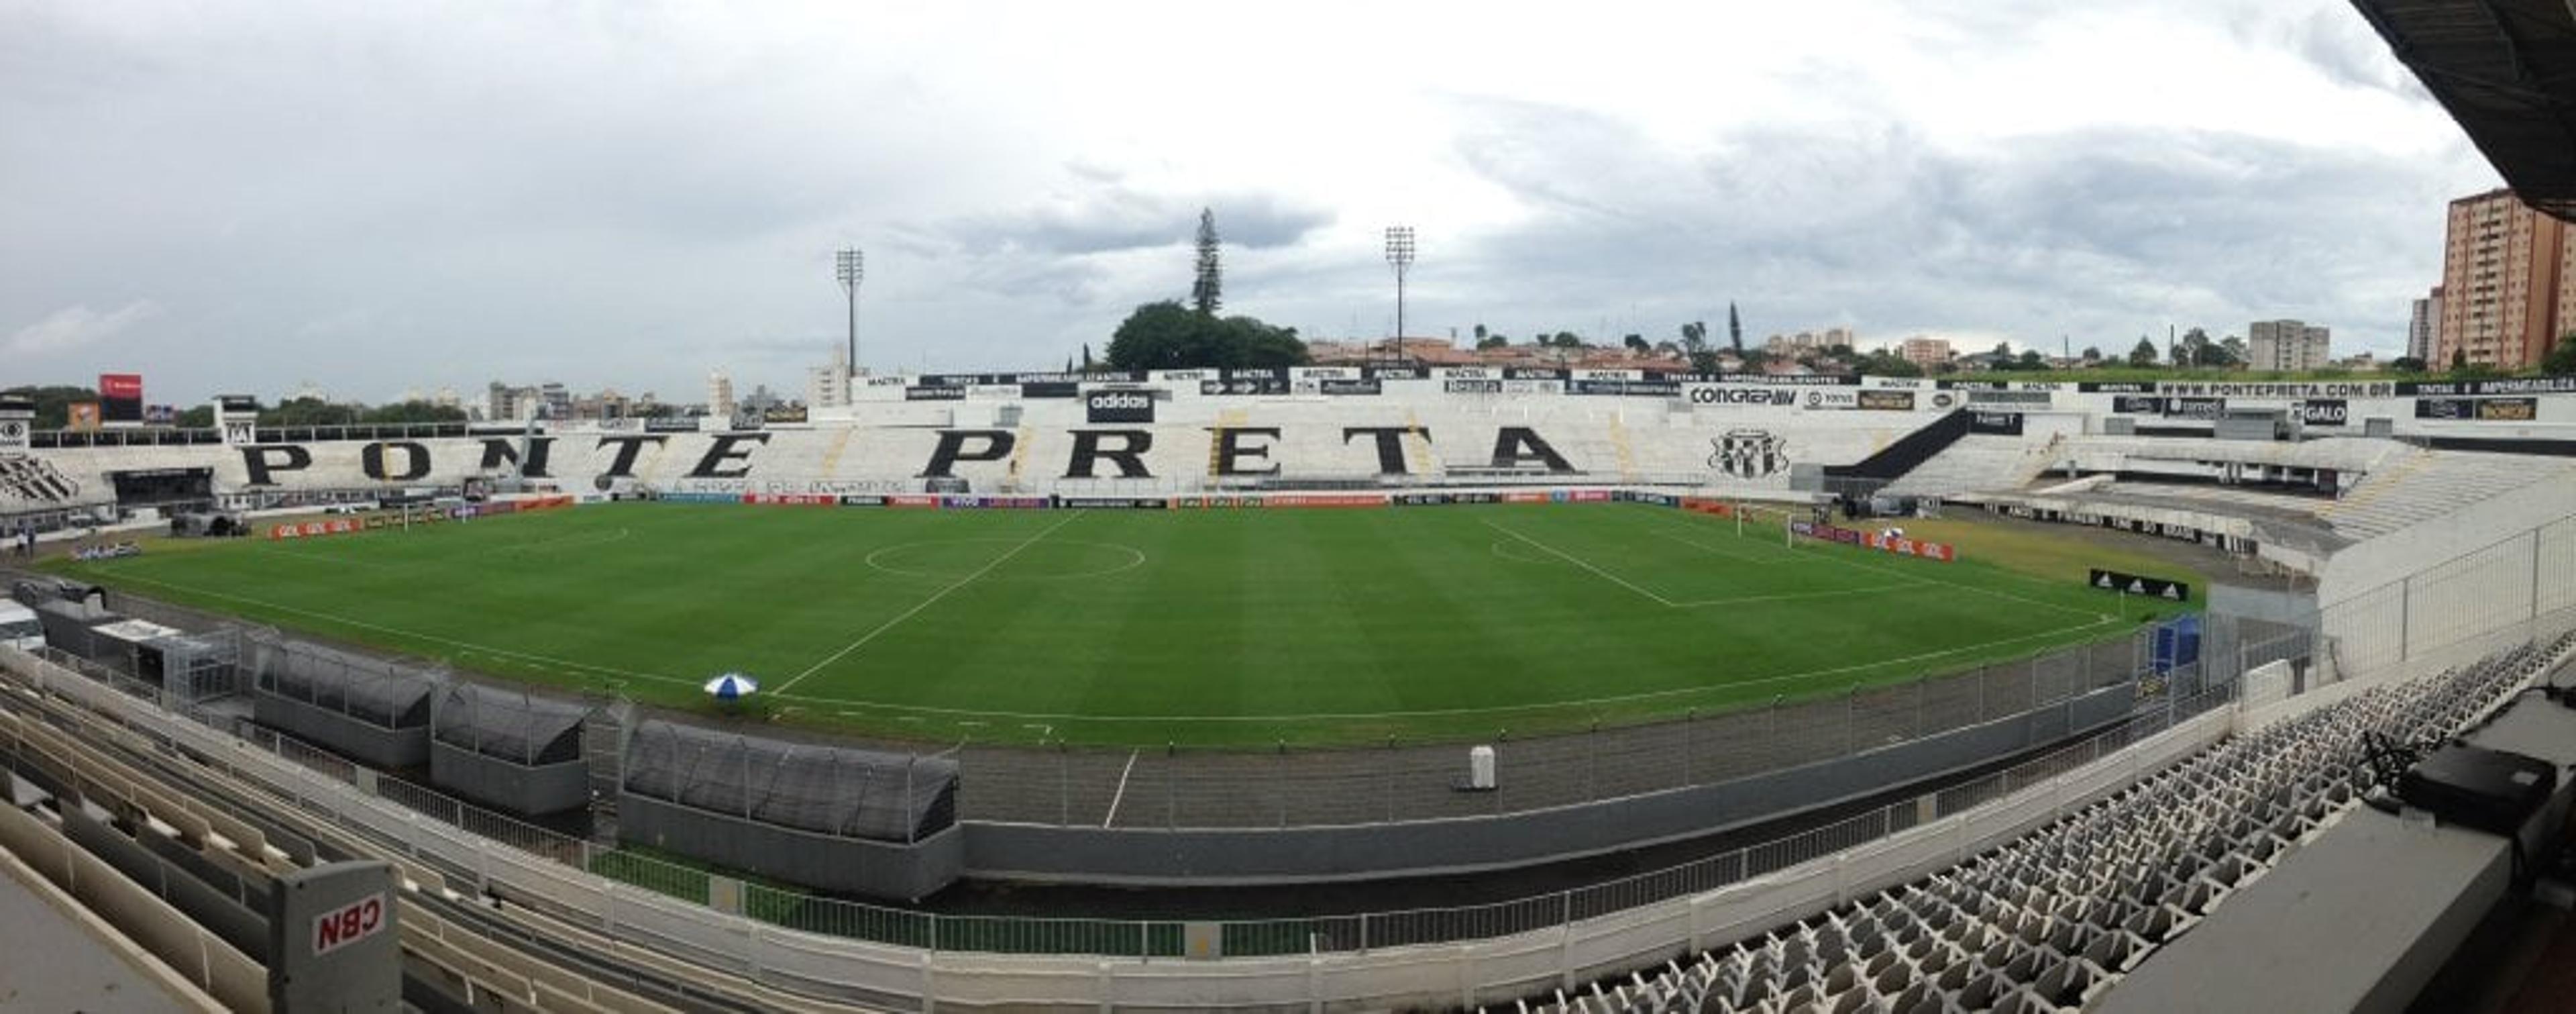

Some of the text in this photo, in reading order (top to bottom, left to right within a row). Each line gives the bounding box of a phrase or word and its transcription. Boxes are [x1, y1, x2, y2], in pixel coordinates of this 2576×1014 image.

[1091, 391, 1149, 409] adidas
[2306, 407, 2346, 421] GALO
[242, 427, 1589, 486] PONTE PRETA
[317, 899, 381, 950] CBN
